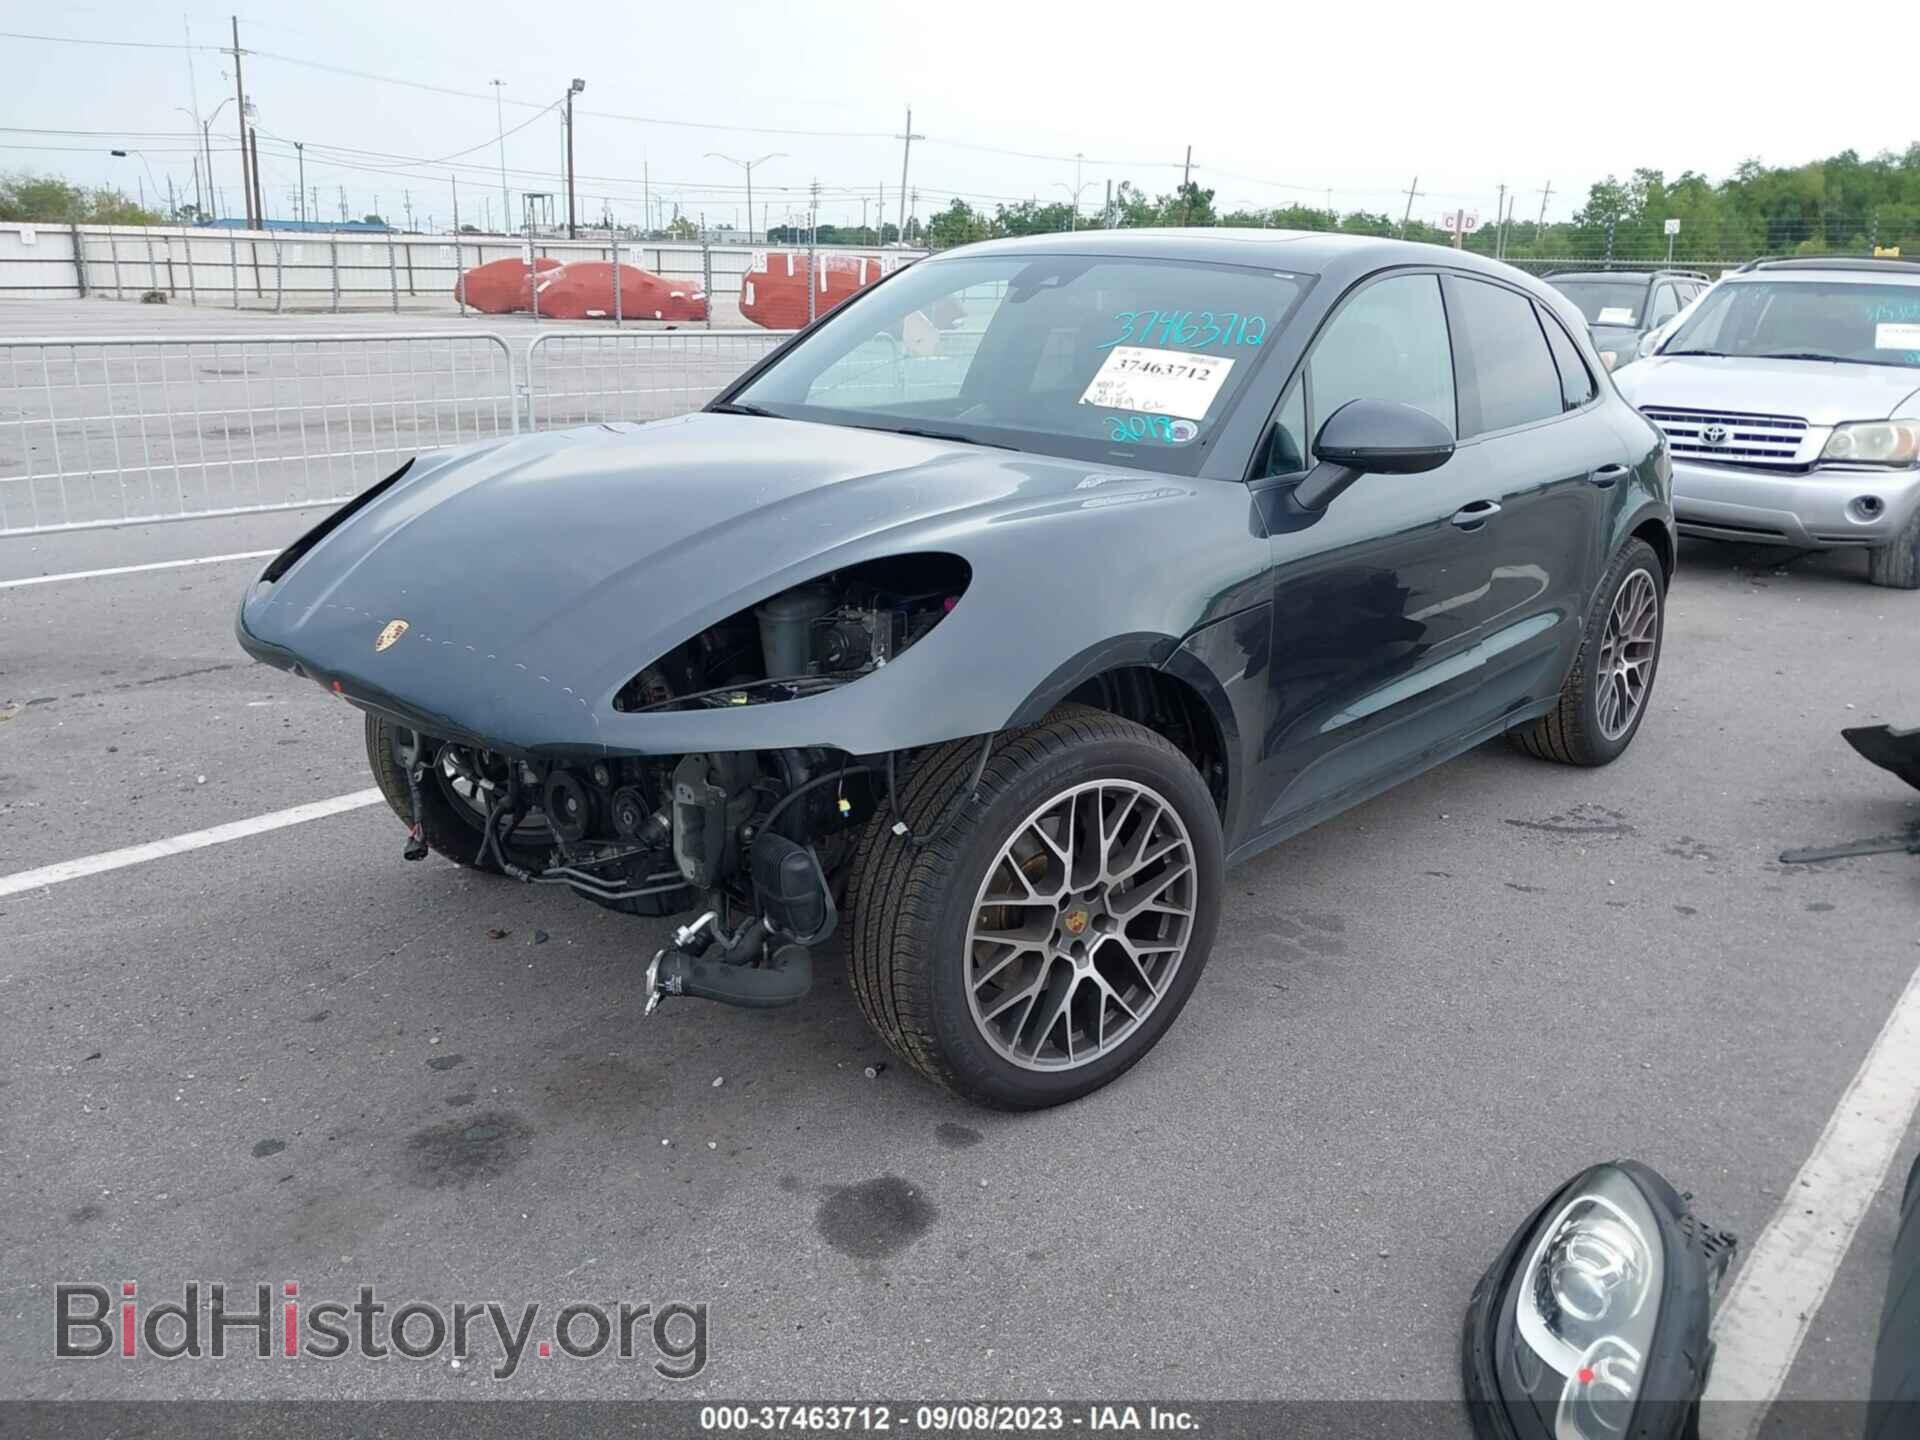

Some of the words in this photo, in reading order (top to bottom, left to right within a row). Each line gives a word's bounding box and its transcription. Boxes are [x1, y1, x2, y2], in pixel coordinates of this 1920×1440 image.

[1445, 216, 1454, 228] C
[1465, 216, 1476, 229] D
[1096, 310, 1266, 349] 37463712
[1113, 359, 1211, 381] 37463712
